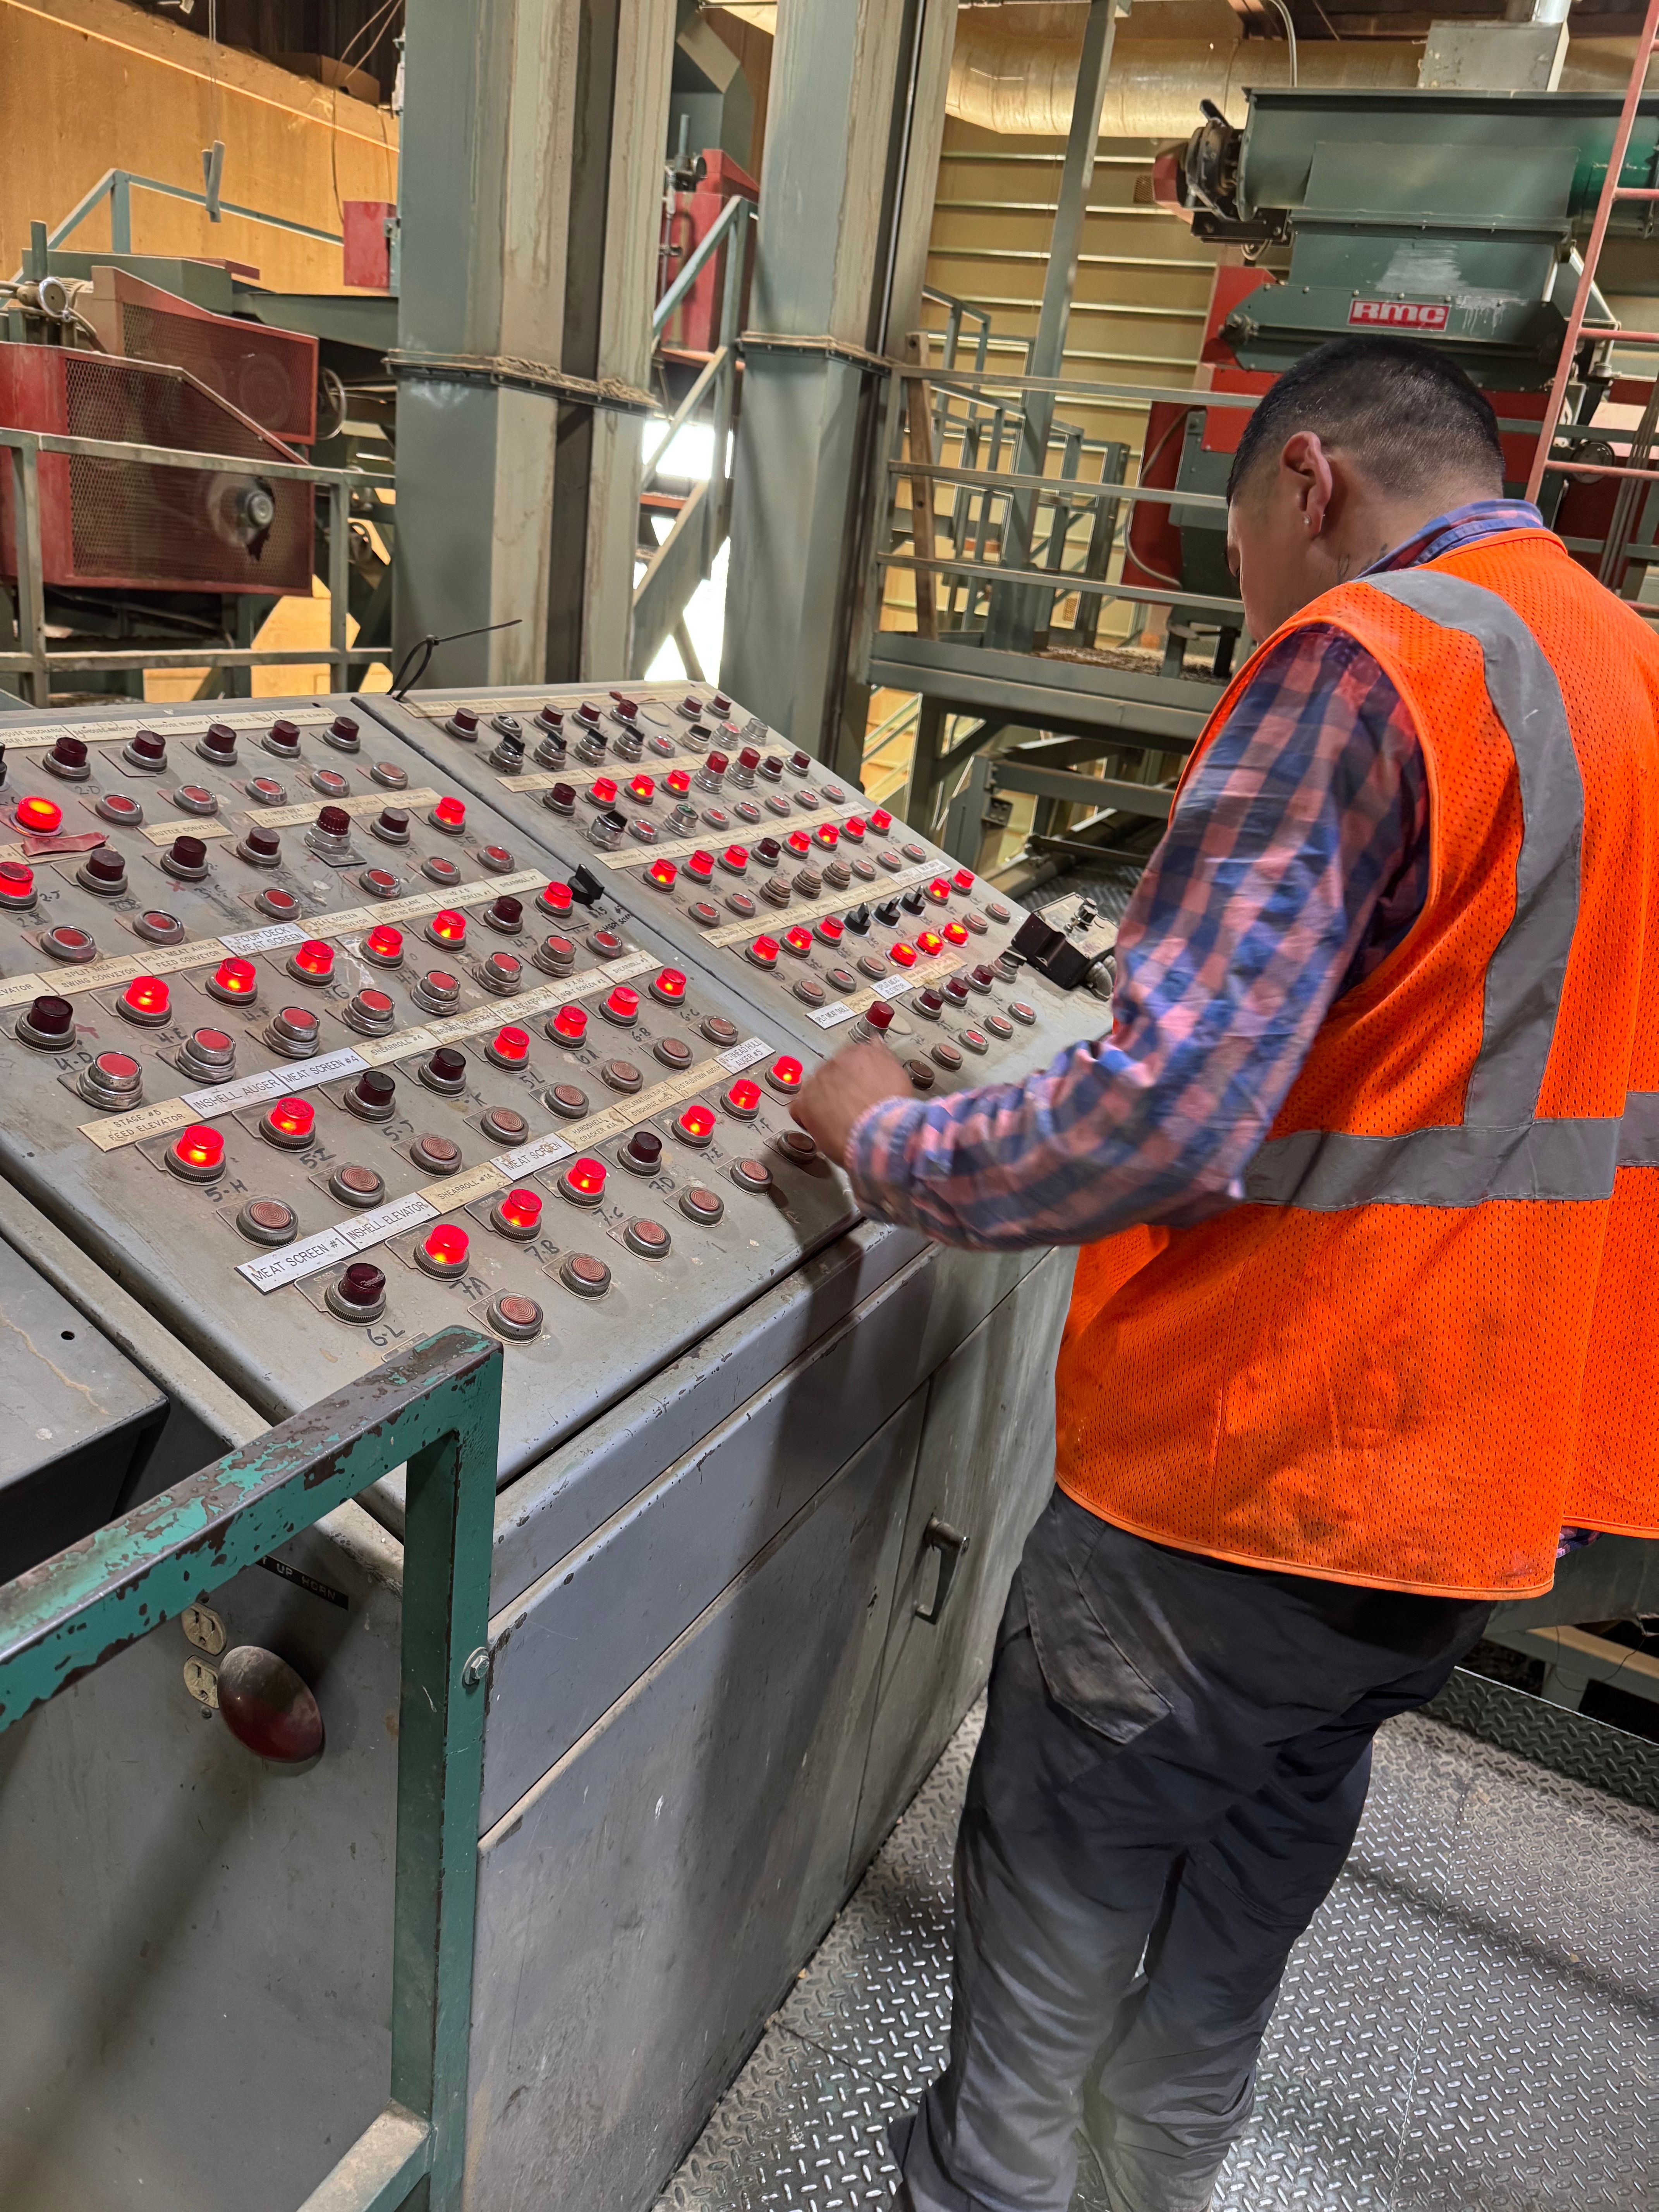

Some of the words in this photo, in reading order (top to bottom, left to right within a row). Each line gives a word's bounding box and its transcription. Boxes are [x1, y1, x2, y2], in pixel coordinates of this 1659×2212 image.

[151, 828, 182, 837] SHUTTLE
[184, 823, 221, 833] CONVEYOR
[380, 903, 405, 911] DOUBLE
[408, 903, 438, 914] CONVEYOR
[333, 912, 358, 922] SCREEN
[234, 932, 262, 944] FOUR
[262, 927, 291, 938] DECK
[237, 941, 266, 953] MEAT
[267, 933, 305, 946] SCREEN
[140, 953, 165, 962] SPLIT
[166, 948, 190, 957] MEAT
[192, 942, 220, 952] AIRLEG
[156, 959, 178, 968] FEED
[179, 950, 222, 963] CONVEYOR
[61, 978, 91, 988] SWING
[93, 968, 139, 981] CONVEYOR
[64, 969, 90, 978] SPLIT
[93, 962, 118, 972] MEAT
[370, 1039, 412, 1056] SHEARROLL
[718, 1045, 749, 1065] OVERHEAD
[747, 1039, 763, 1049] HULL
[280, 1069, 310, 1083] MEAT
[310, 1058, 345, 1075] SCREEN
[345, 1055, 360, 1065] #4
[735, 1053, 756, 1067] AUGER
[675, 1073, 708, 1091] DISTRIBUTION
[707, 1065, 722, 1076] AUGER
[193, 1091, 242, 1110] INSHELL
[242, 1079, 281, 1096] AUGER
[618, 1093, 654, 1113] RECLAMATION
[653, 1085, 670, 1096] AIRLEG
[113, 1114, 145, 1128] STAGE
[147, 1109, 161, 1118] #5
[631, 1102, 659, 1117] DISCHARGE
[108, 1130, 134, 1140] FEED
[136, 1113, 186, 1132] ELEVATOR
[572, 1118, 605, 1135] HARDSHELL
[579, 1127, 606, 1143] CRACKER
[504, 1154, 531, 1171] MEAT
[437, 1180, 480, 1200] SHEARROLL
[346, 1220, 386, 1240] INSHELL
[381, 1201, 426, 1225] ELEVATOR
[251, 1261, 286, 1282] MEAT
[285, 1243, 330, 1267] SCREEN
[329, 1237, 345, 1249] #1
[276, 1563, 293, 1576] UP
[302, 1575, 336, 1600] HORN
